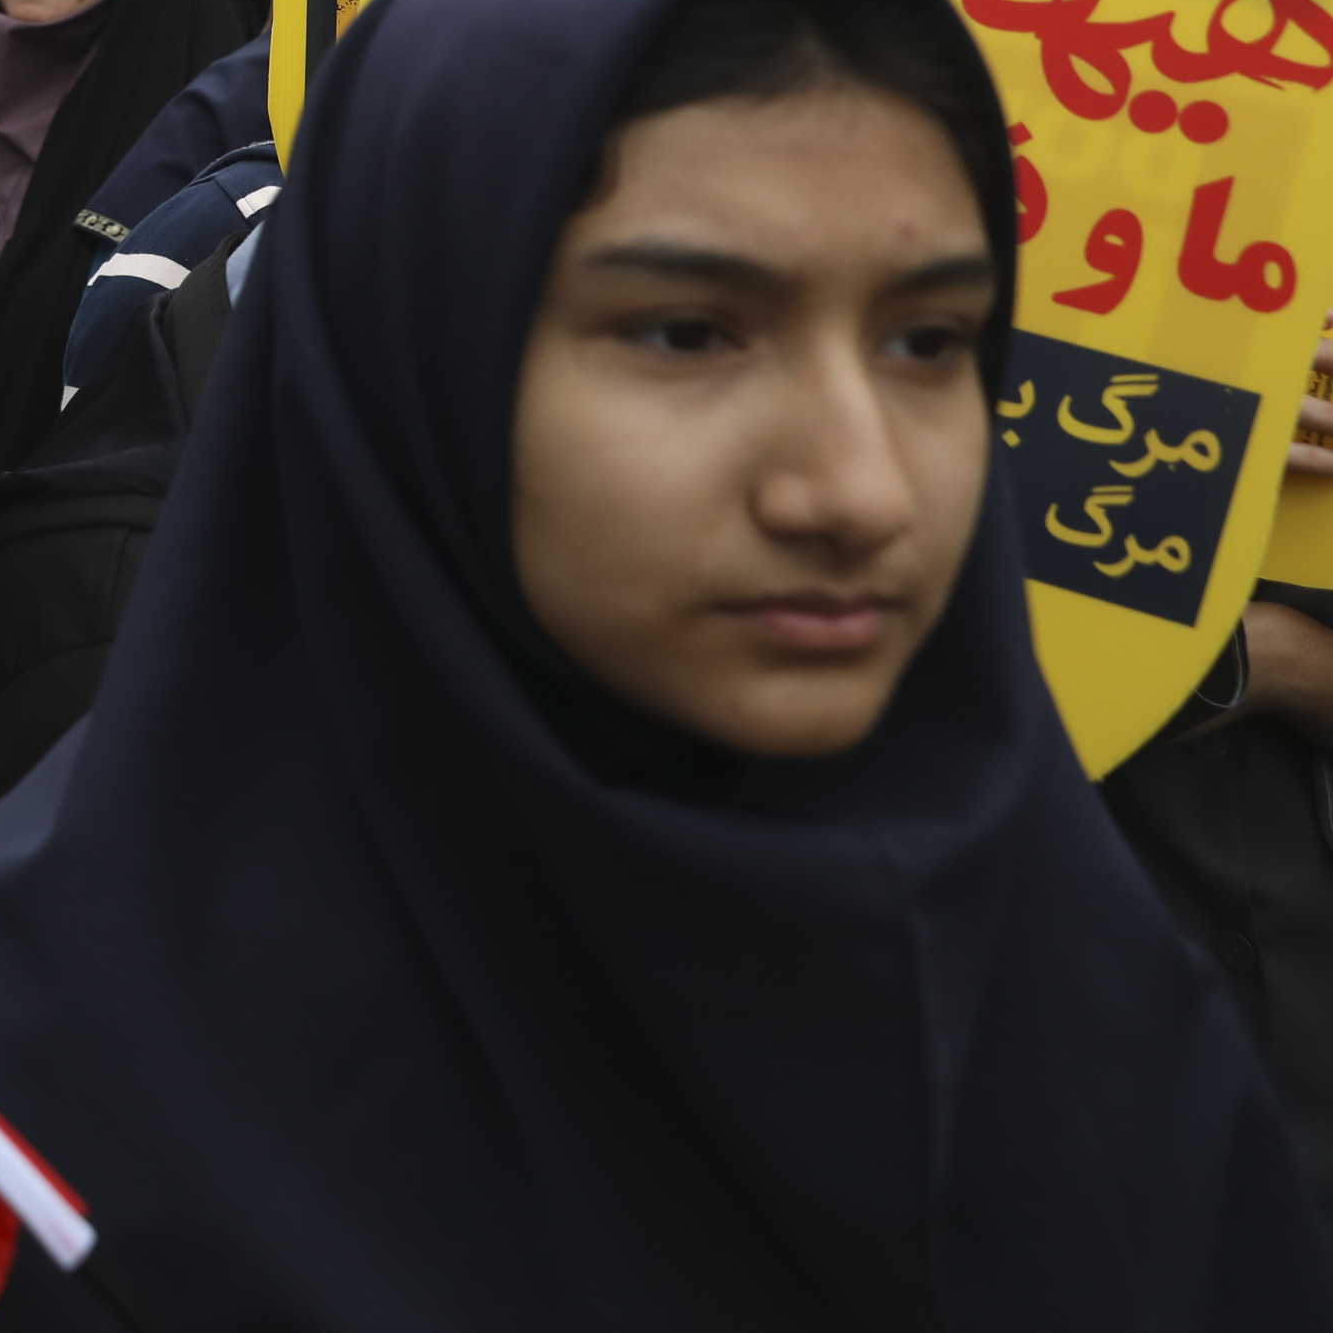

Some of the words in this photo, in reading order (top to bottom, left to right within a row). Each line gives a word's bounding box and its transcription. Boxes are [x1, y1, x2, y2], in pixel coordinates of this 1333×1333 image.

[1050, 207, 1144, 316] و
[1177, 175, 1298, 314] ما
[1055, 372, 1223, 478] مرگ
[1044, 484, 1192, 578] مرگ
